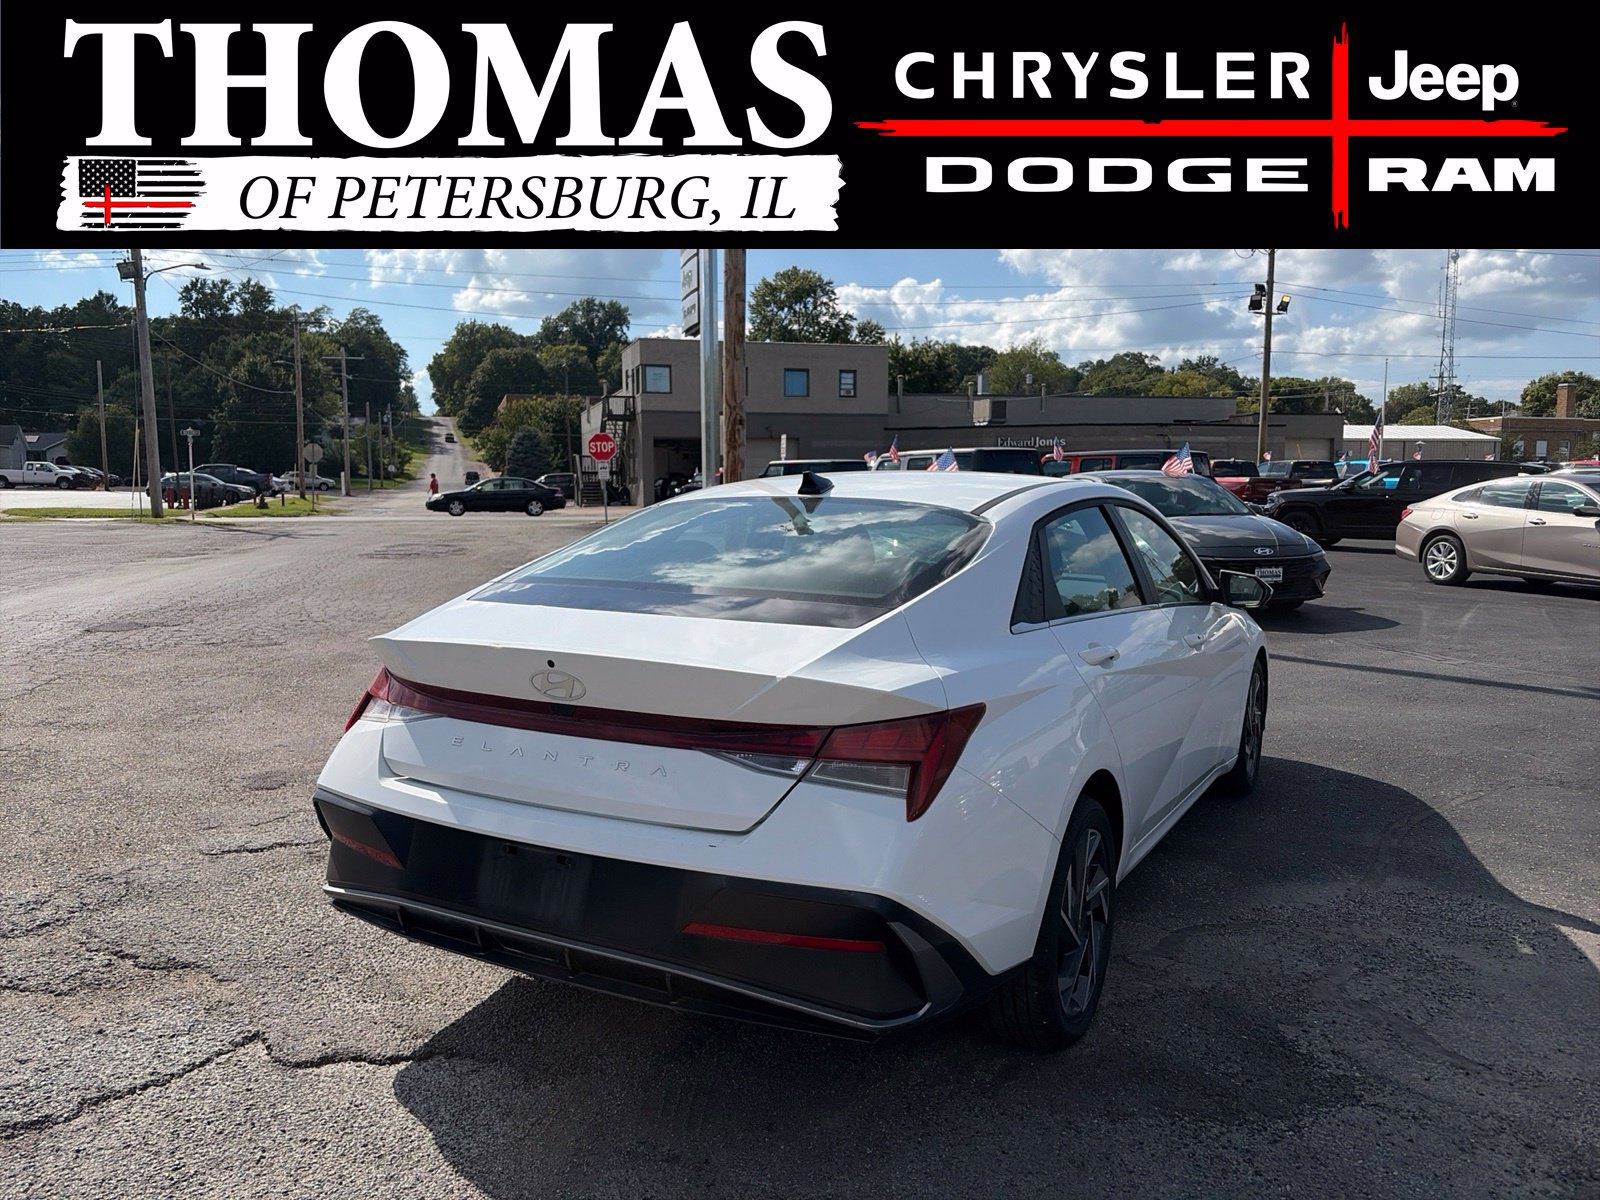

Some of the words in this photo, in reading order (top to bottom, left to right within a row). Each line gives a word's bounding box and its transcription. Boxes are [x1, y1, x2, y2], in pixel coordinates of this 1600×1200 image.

[590, 441, 614, 453] STOP
[997, 436, 1034, 447] Edward
[1255, 568, 1281, 577] THOMAS
[451, 736, 668, 778] ELANTRA
